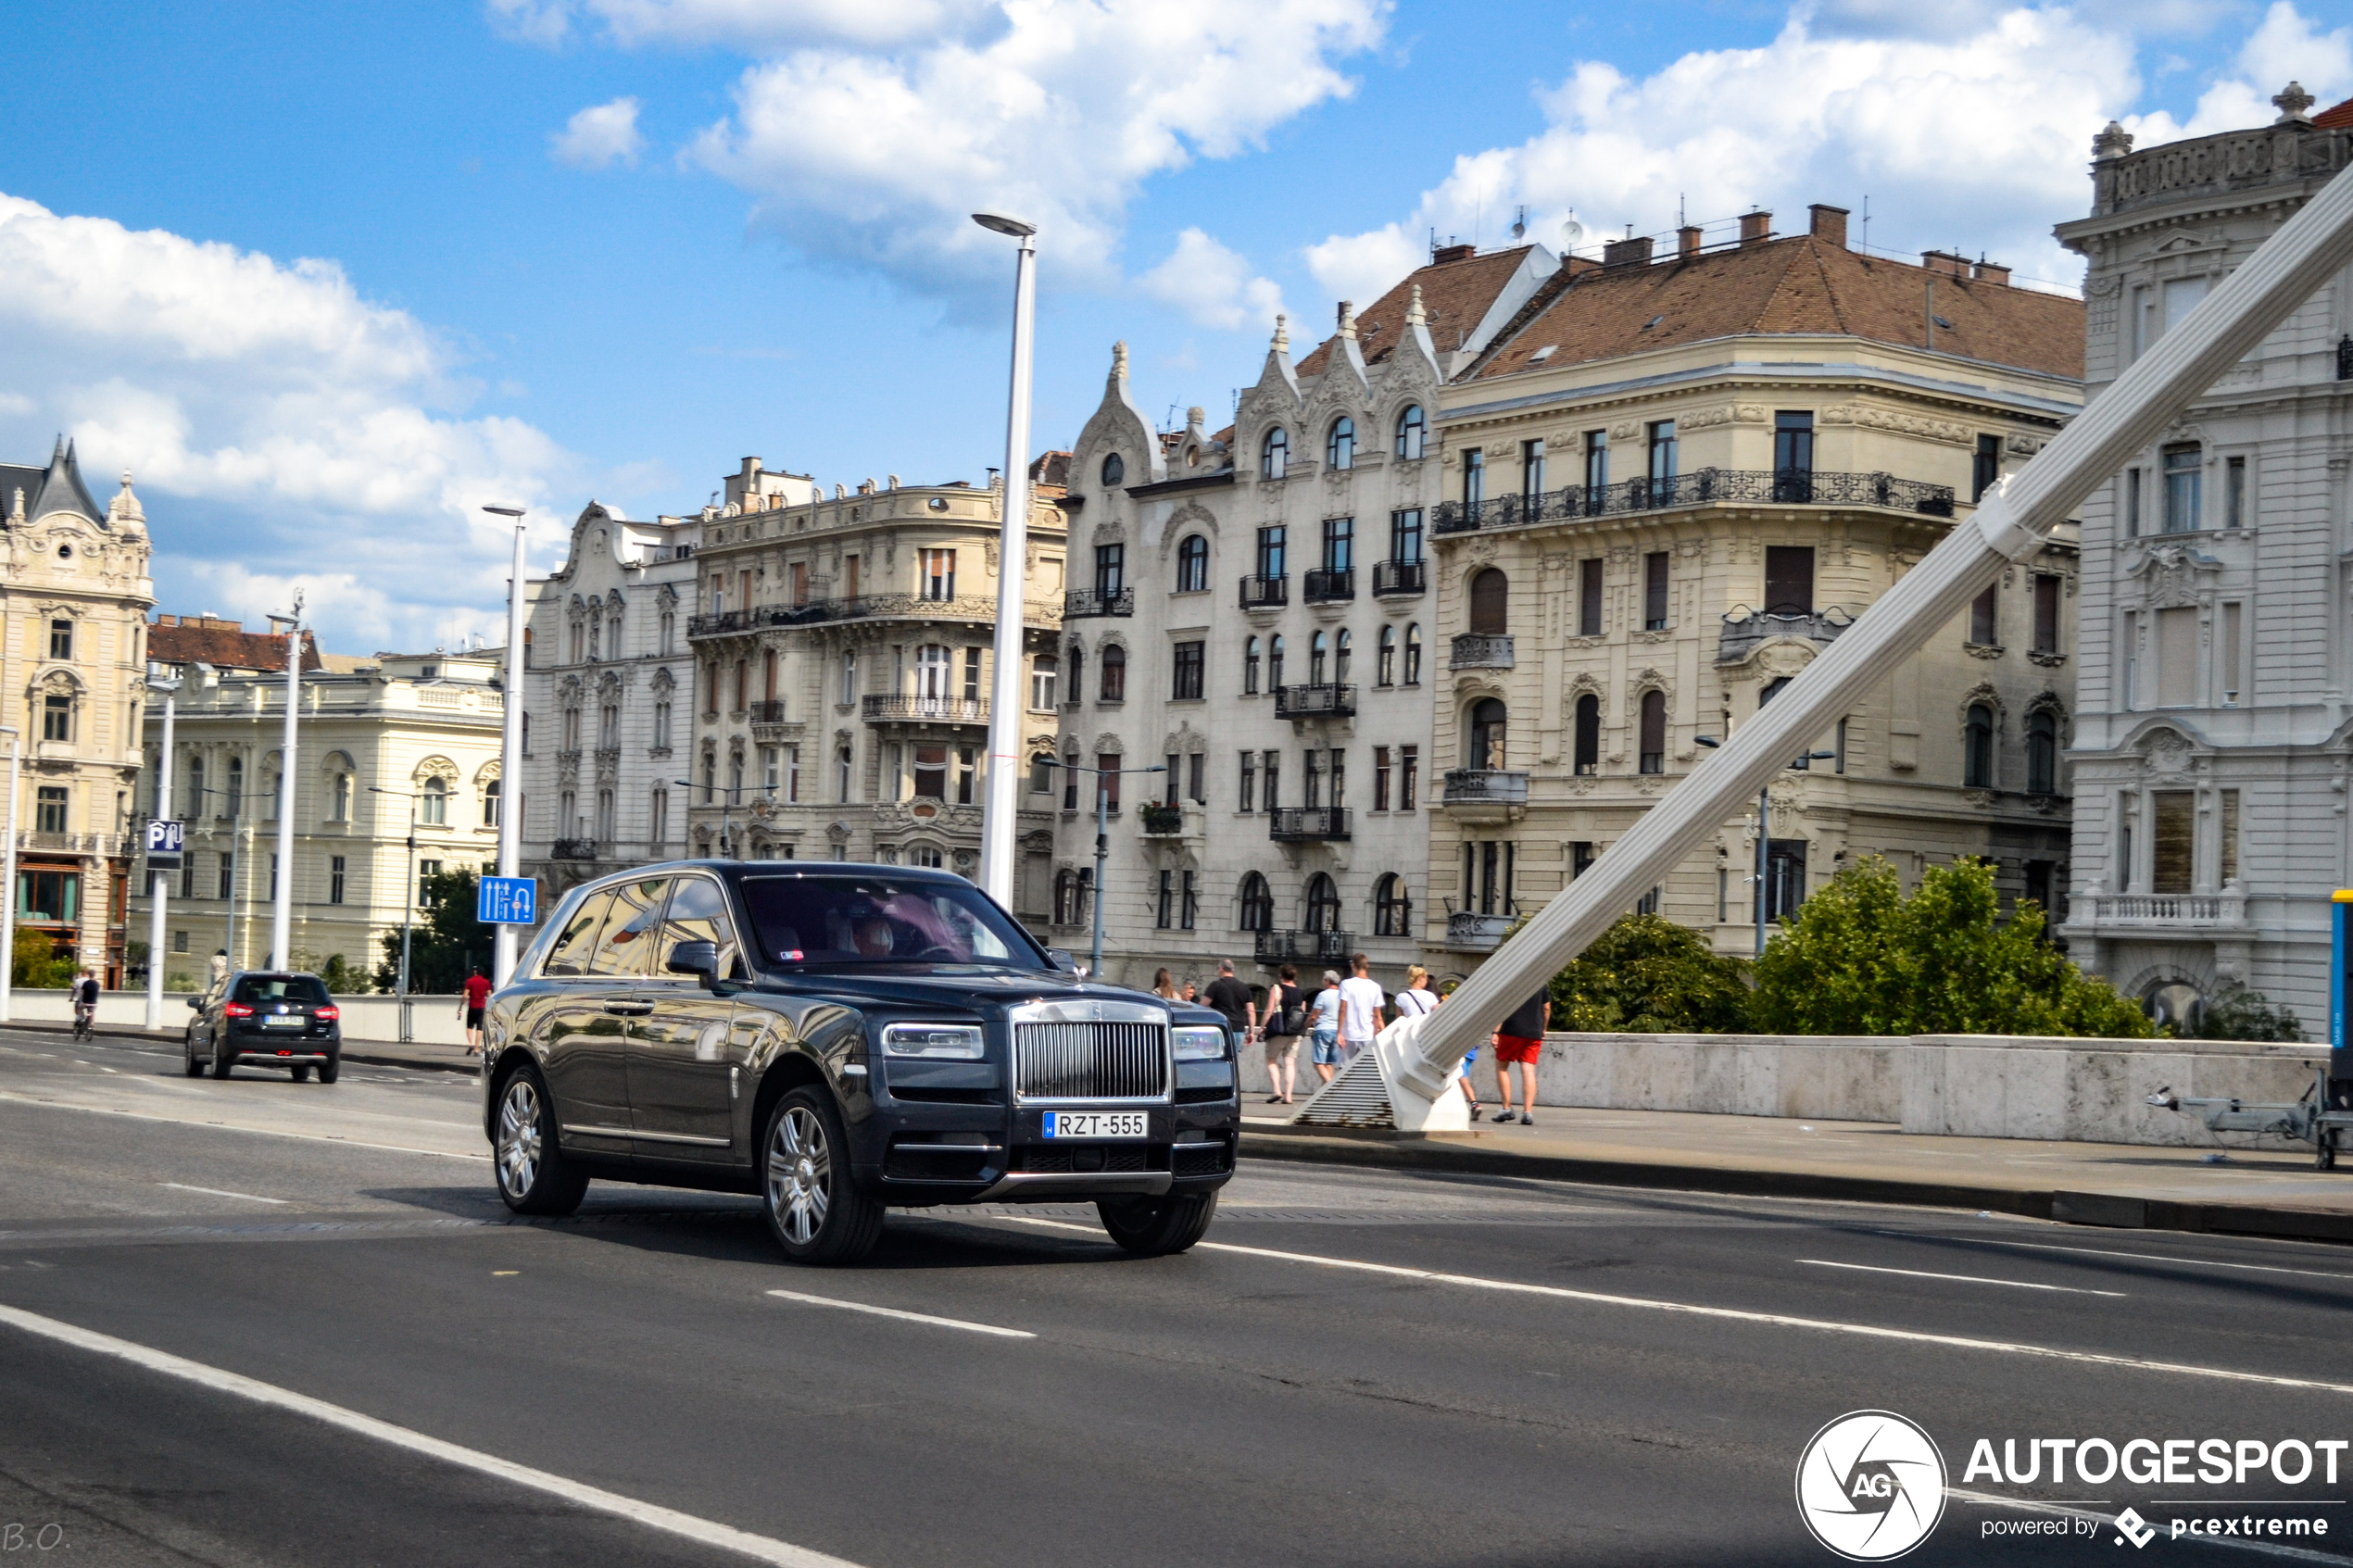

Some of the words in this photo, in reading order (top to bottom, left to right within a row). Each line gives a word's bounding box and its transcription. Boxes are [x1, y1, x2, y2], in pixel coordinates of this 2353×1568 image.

[149, 826, 166, 849] P
[1046, 1126, 1053, 1135] H
[1059, 1115, 1143, 1135] RZT-555
